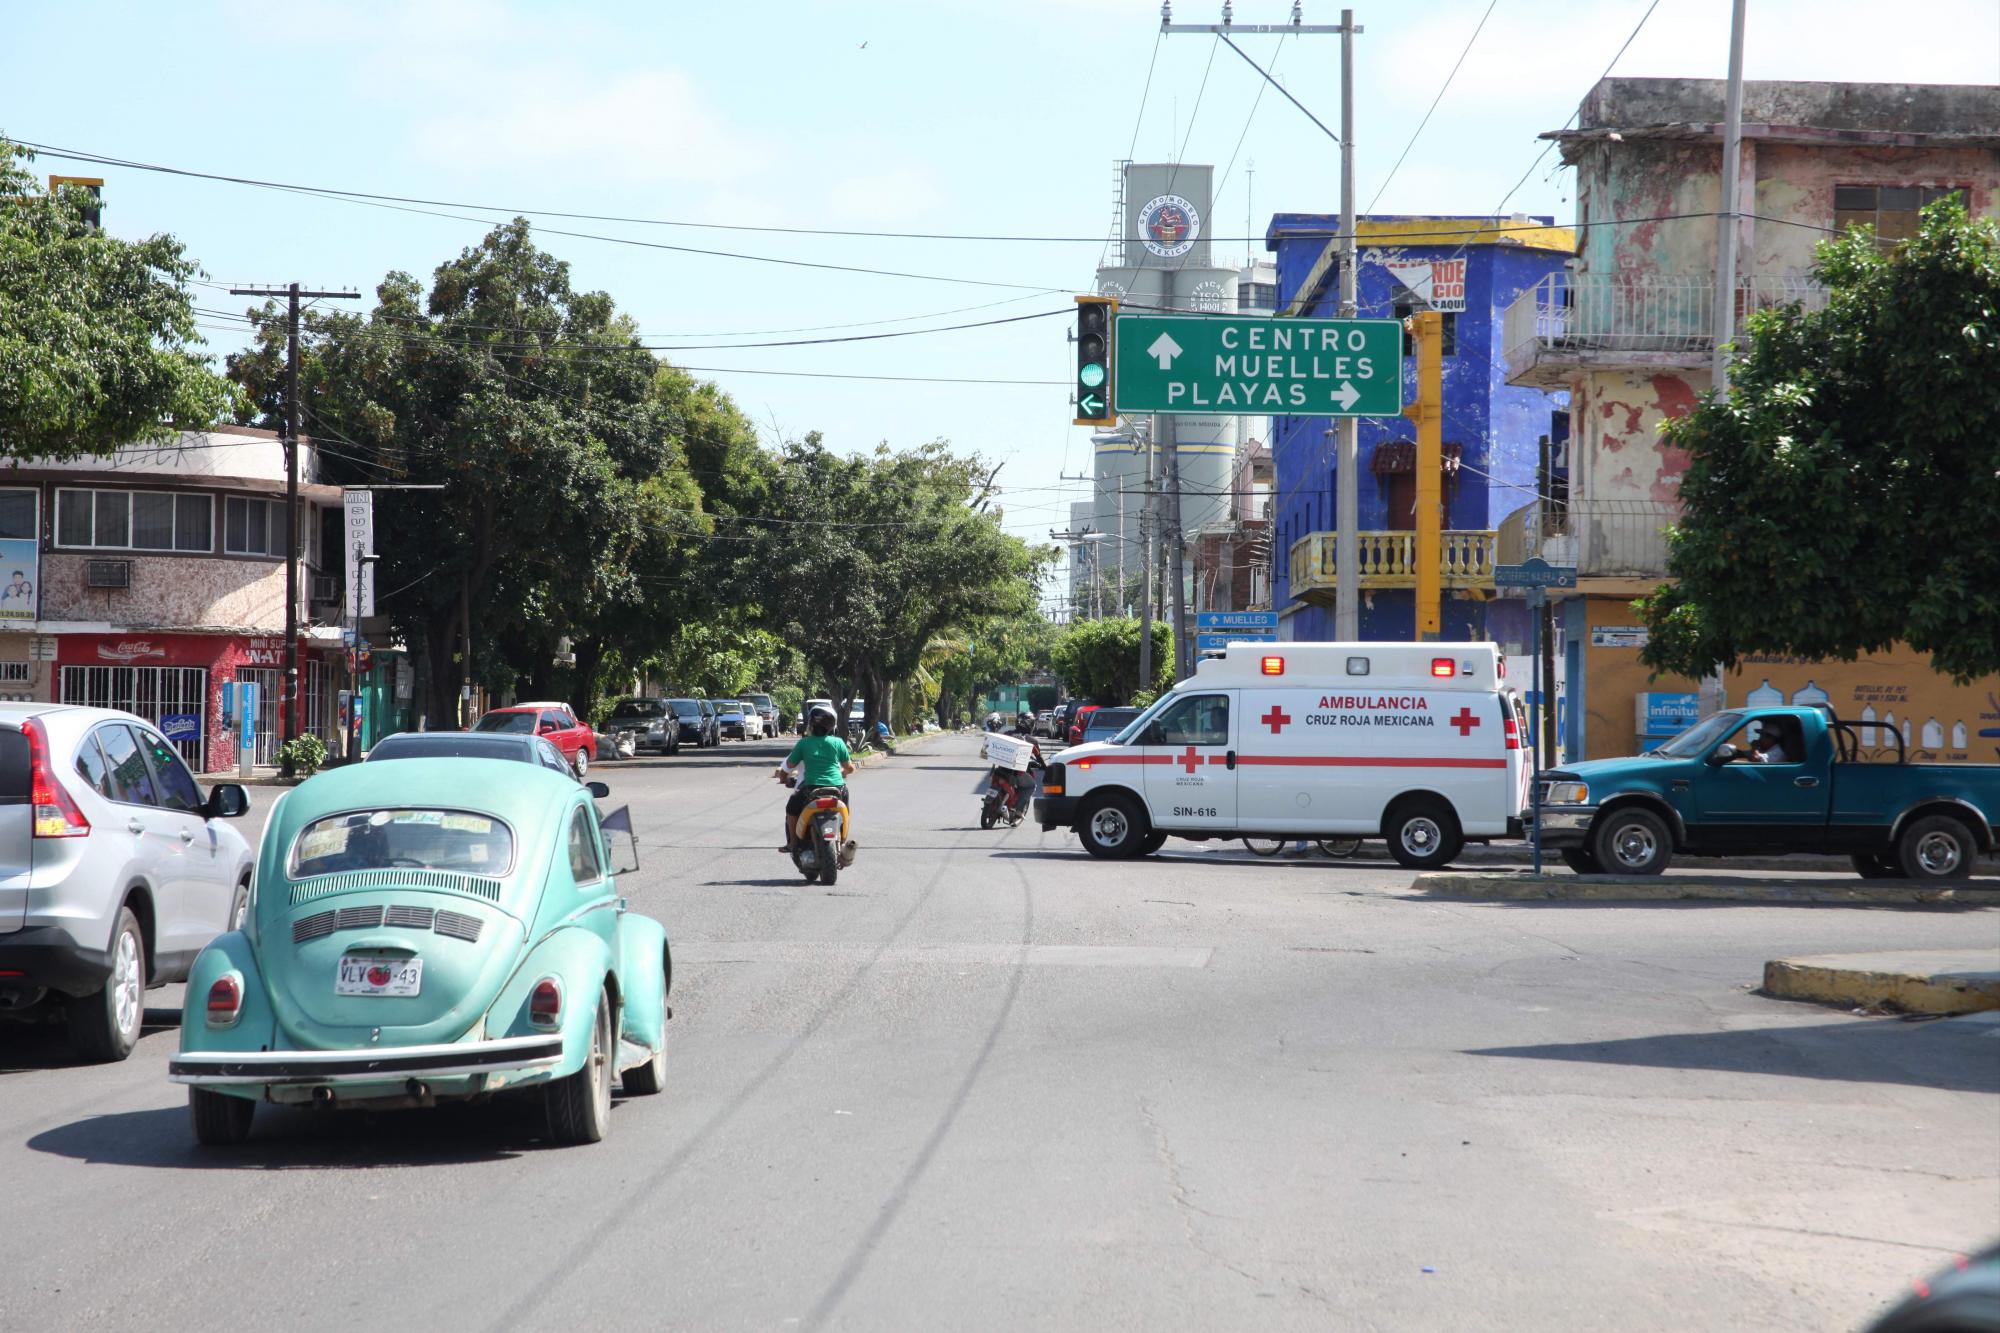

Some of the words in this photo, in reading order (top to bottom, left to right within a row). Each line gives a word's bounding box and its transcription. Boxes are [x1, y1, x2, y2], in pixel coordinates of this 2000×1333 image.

[1139, 198, 1165, 225] GRUPO
[1169, 197, 1199, 226] MODELO
[1147, 243, 1188, 256] MEXICO
[1200, 292, 1220, 301] ISO
[1433, 284, 1464, 298] CIO
[1200, 302, 1220, 311] 14001
[1440, 299, 1464, 309] AQUI
[1221, 327, 1366, 351] CENTRO
[1215, 354, 1374, 379] MUELLES
[1168, 382, 1307, 406] PLAYAS
[345, 491, 369, 504] MINI
[1223, 615, 1268, 625] MUELLES
[250, 638, 268, 648] MINI
[1318, 696, 1428, 709] AMBULANCIA
[1306, 715, 1337, 726] CRUZ
[1340, 715, 1371, 726] ROJA
[1374, 716, 1434, 727] MEXICANA
[1173, 806, 1217, 817] SIN-616
